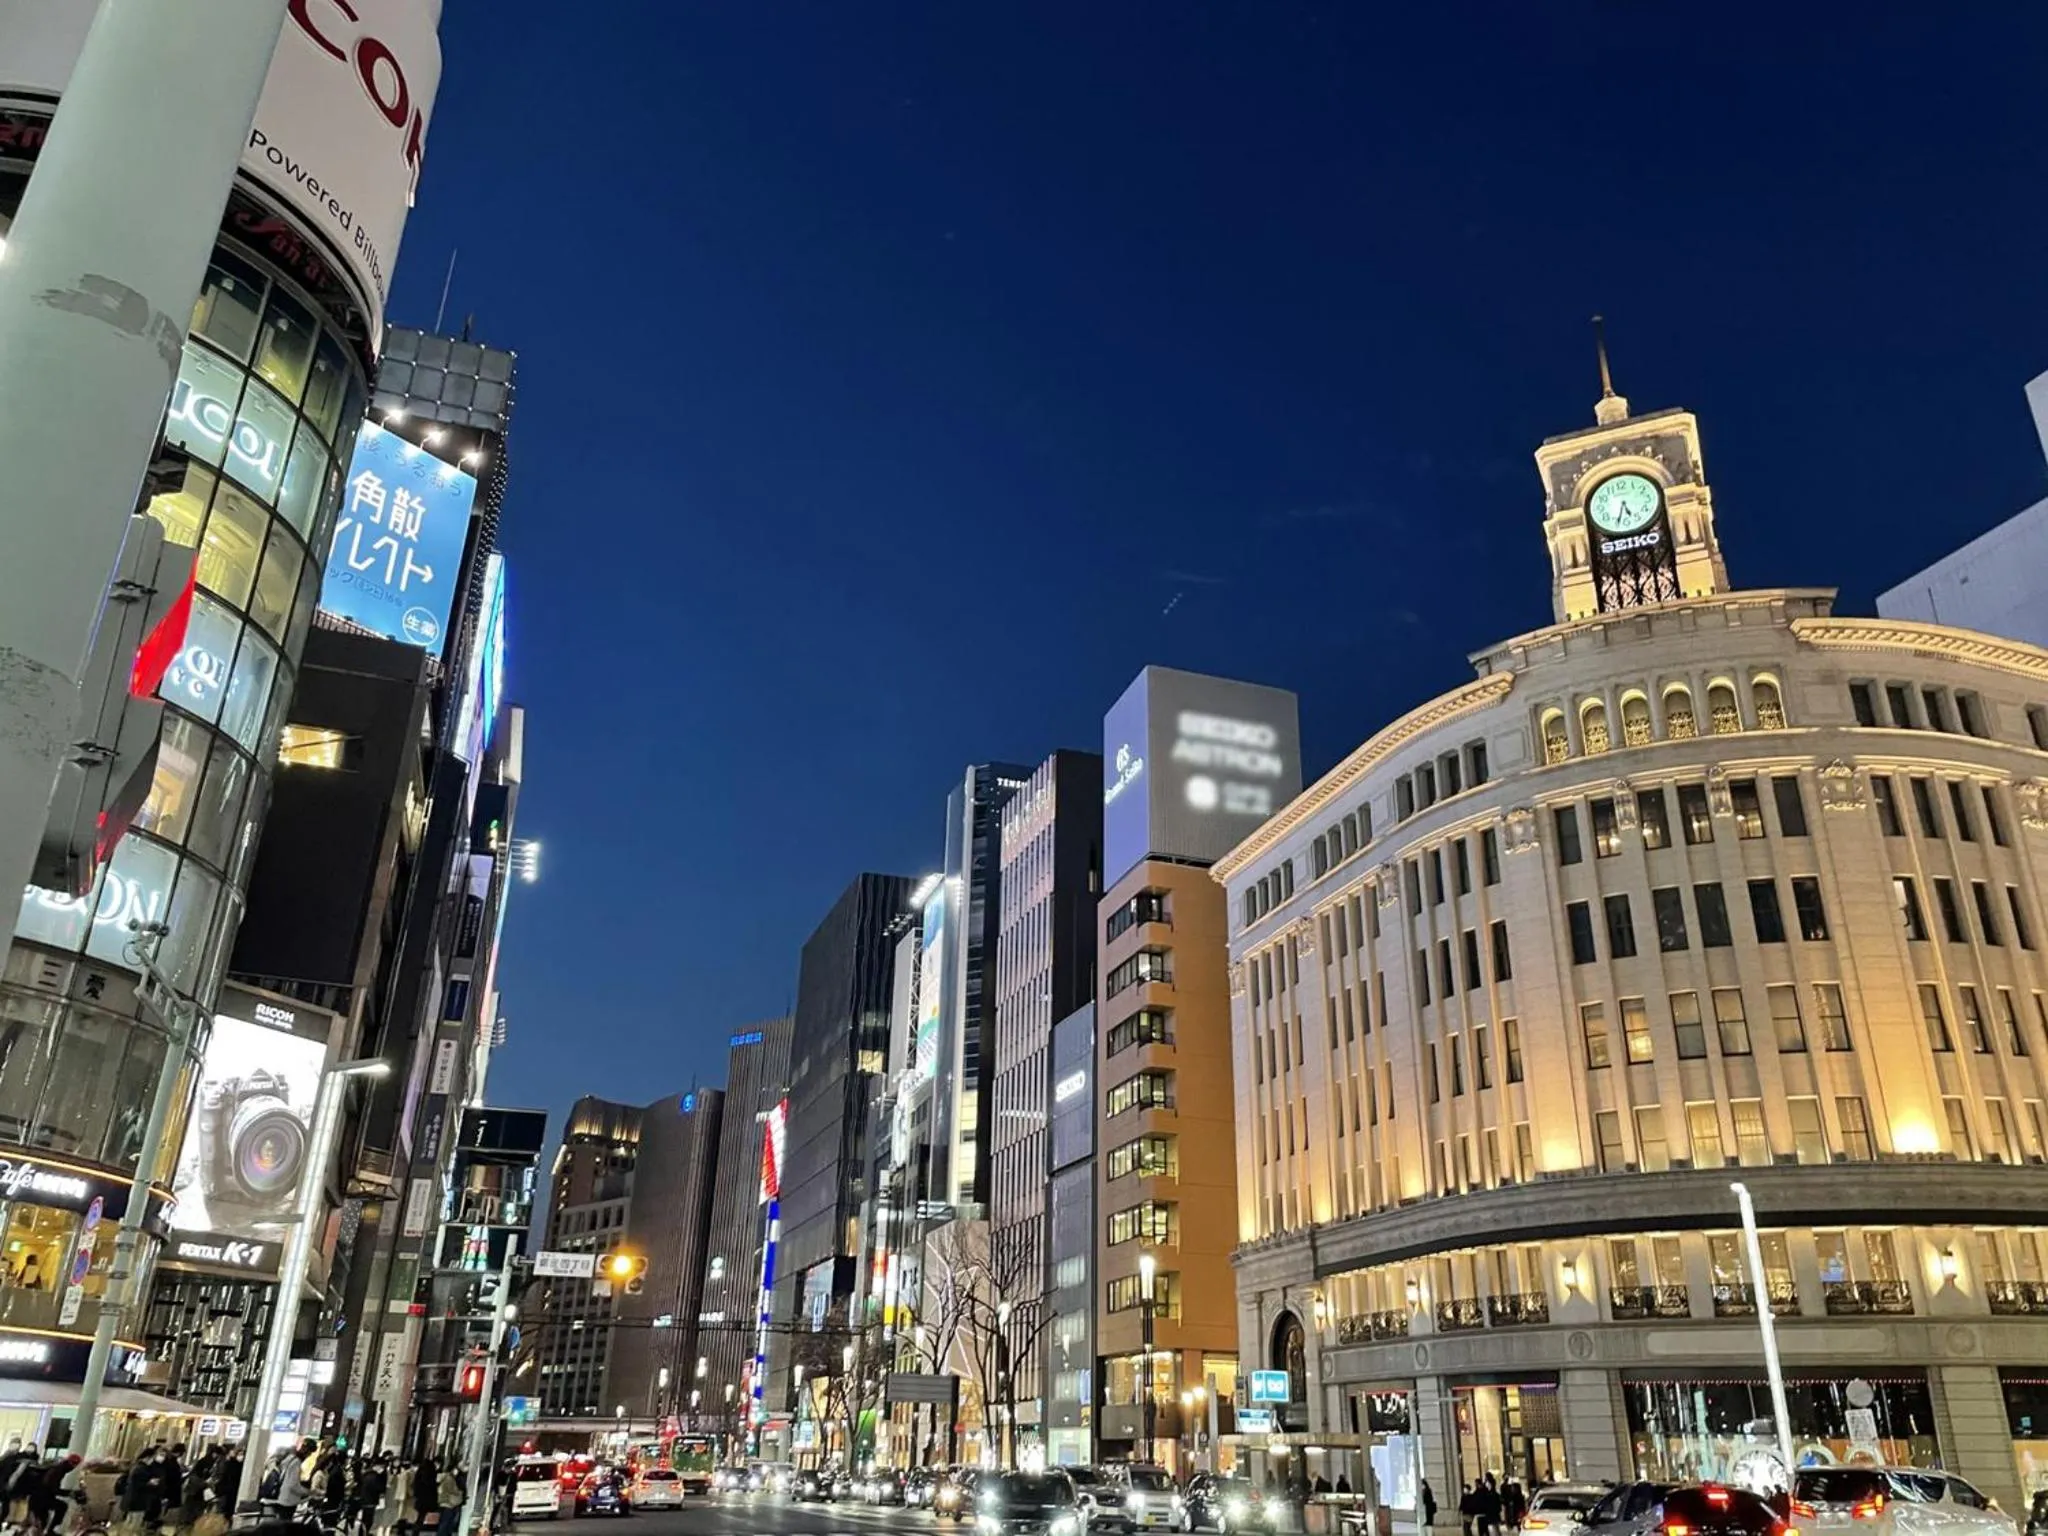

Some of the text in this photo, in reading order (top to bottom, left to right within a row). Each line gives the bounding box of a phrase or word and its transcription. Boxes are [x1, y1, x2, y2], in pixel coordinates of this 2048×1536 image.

[248, 128, 354, 232] Powered
[351, 469, 427, 543] 角散
[1601, 532, 1660, 554] SEIKO
[255, 1003, 295, 1023] RICOH
[178, 1242, 222, 1261] PENTAX
